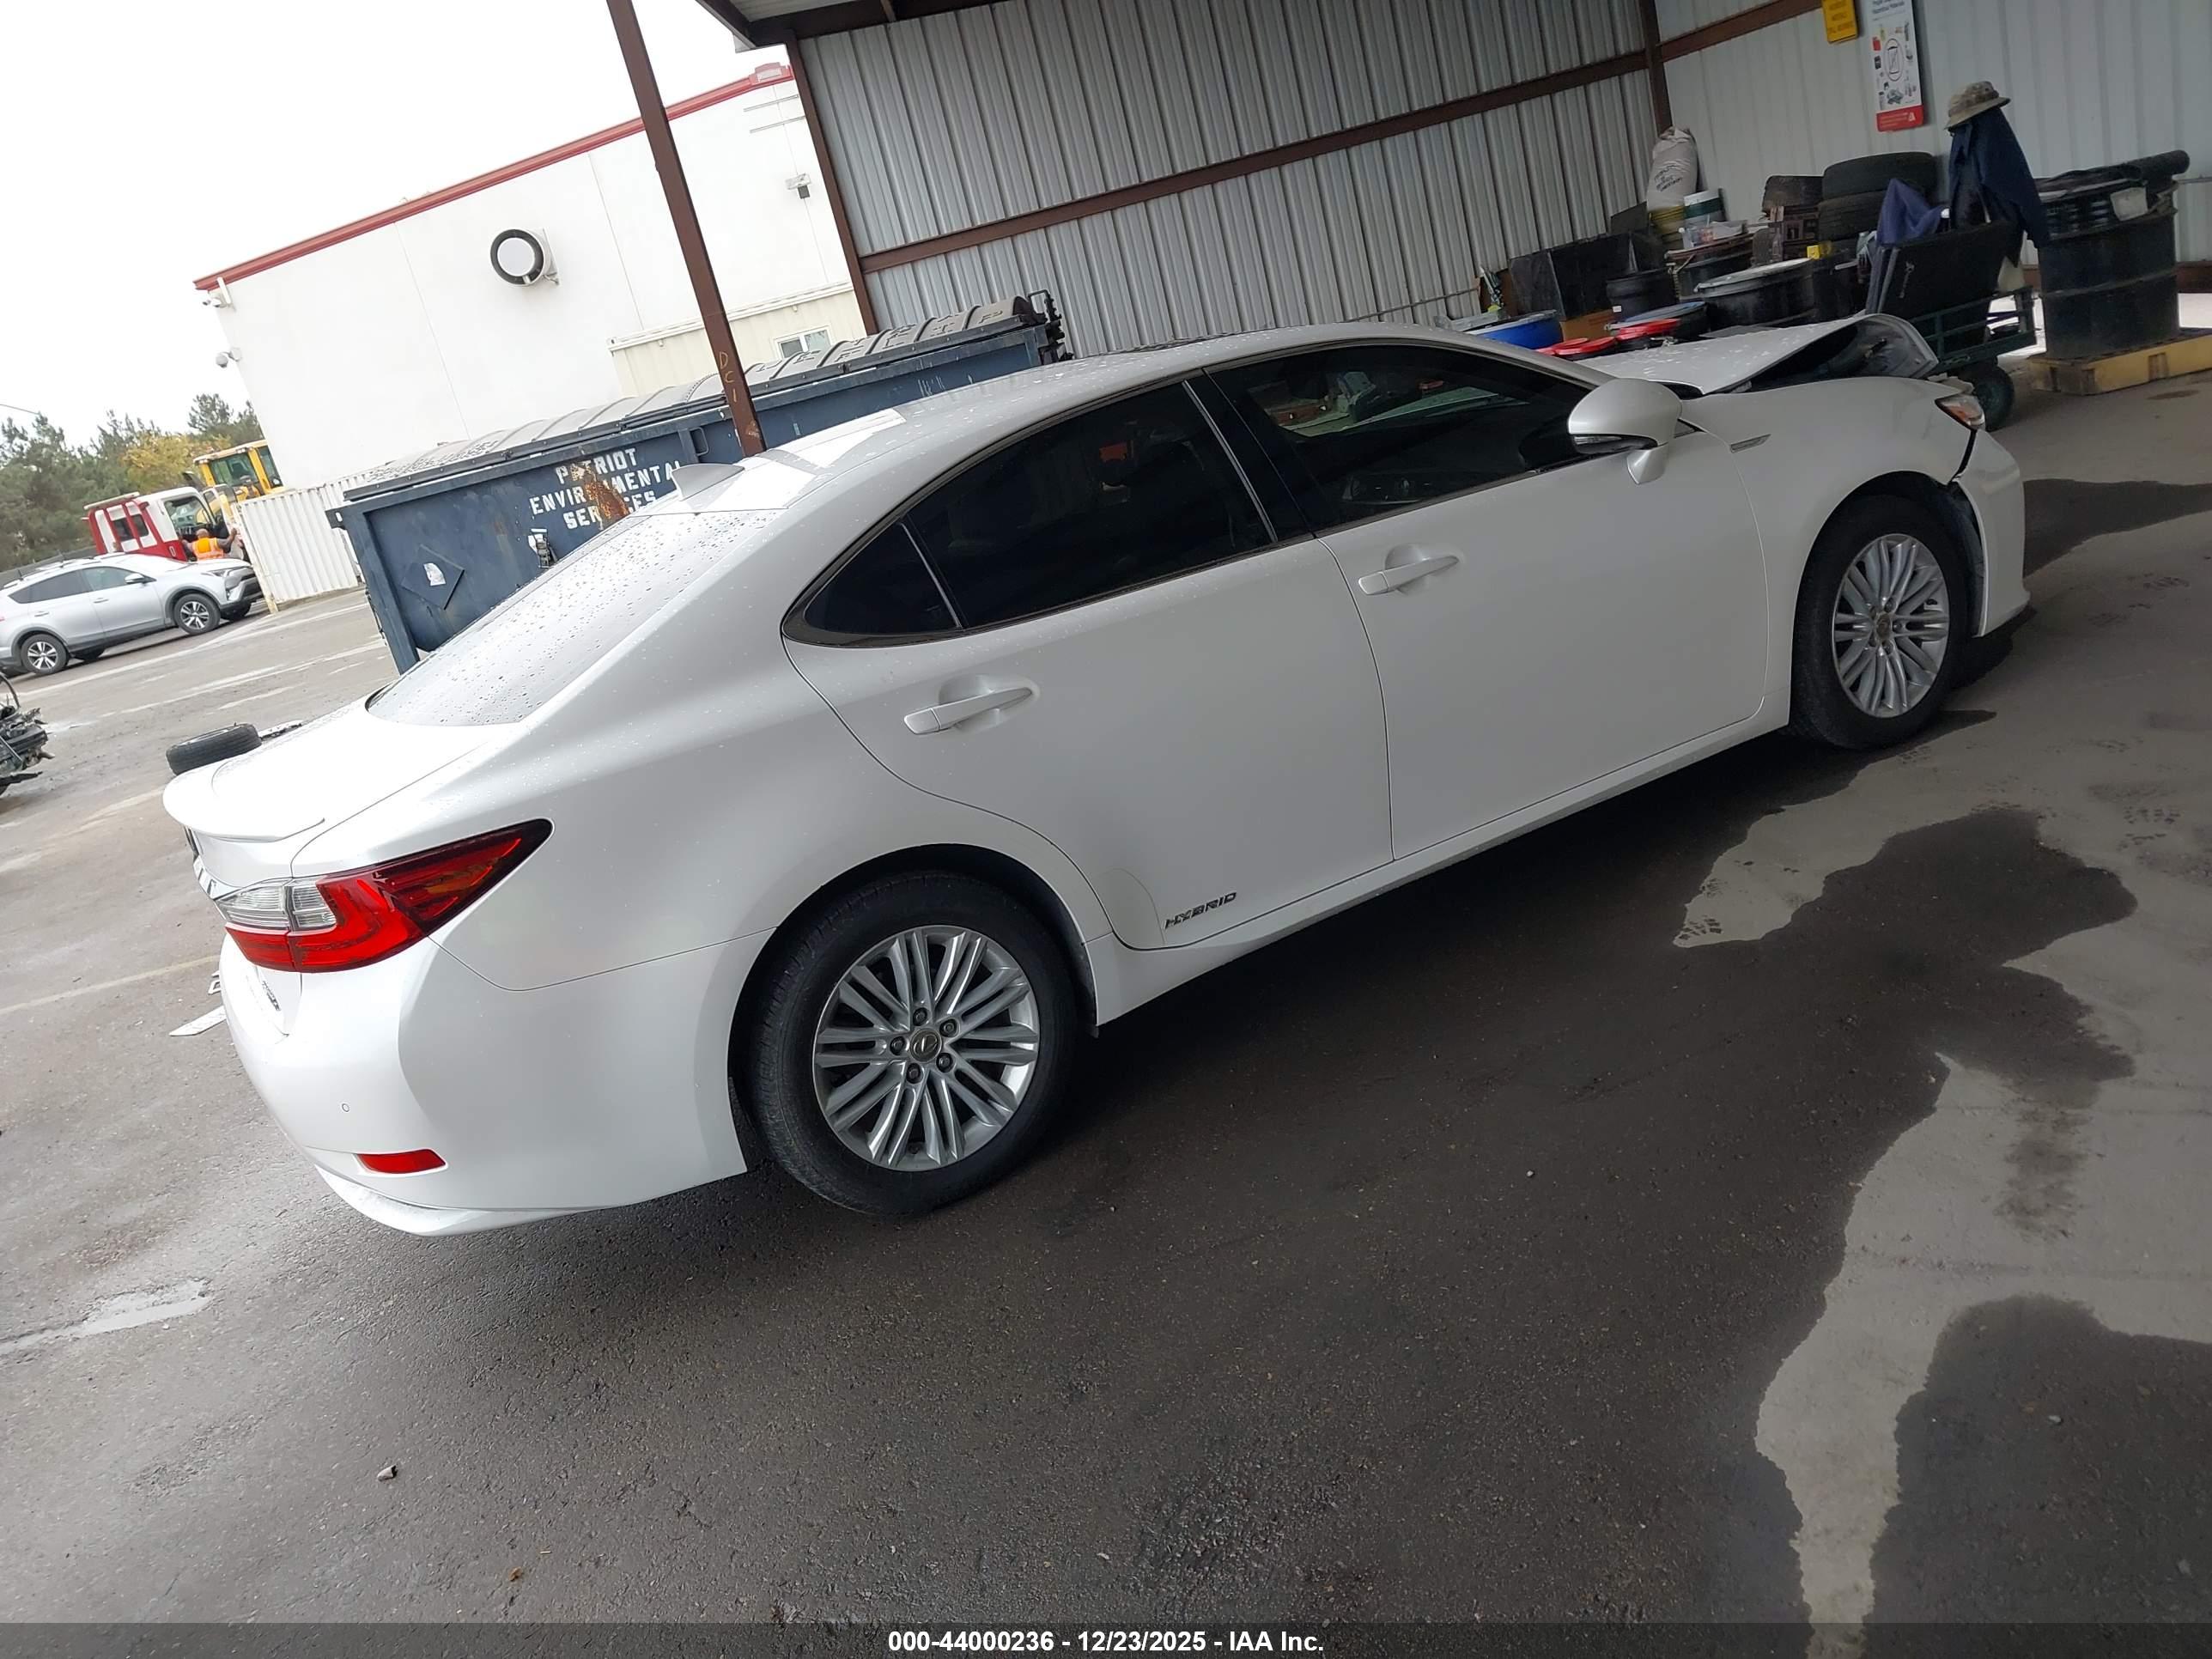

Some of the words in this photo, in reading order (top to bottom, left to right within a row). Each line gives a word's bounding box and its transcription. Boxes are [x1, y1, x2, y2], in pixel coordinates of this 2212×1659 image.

[556, 447, 636, 484] PATRIOT
[529, 460, 681, 515] ENVIRMENTA
[1164, 891, 1237, 929] HYBRID
